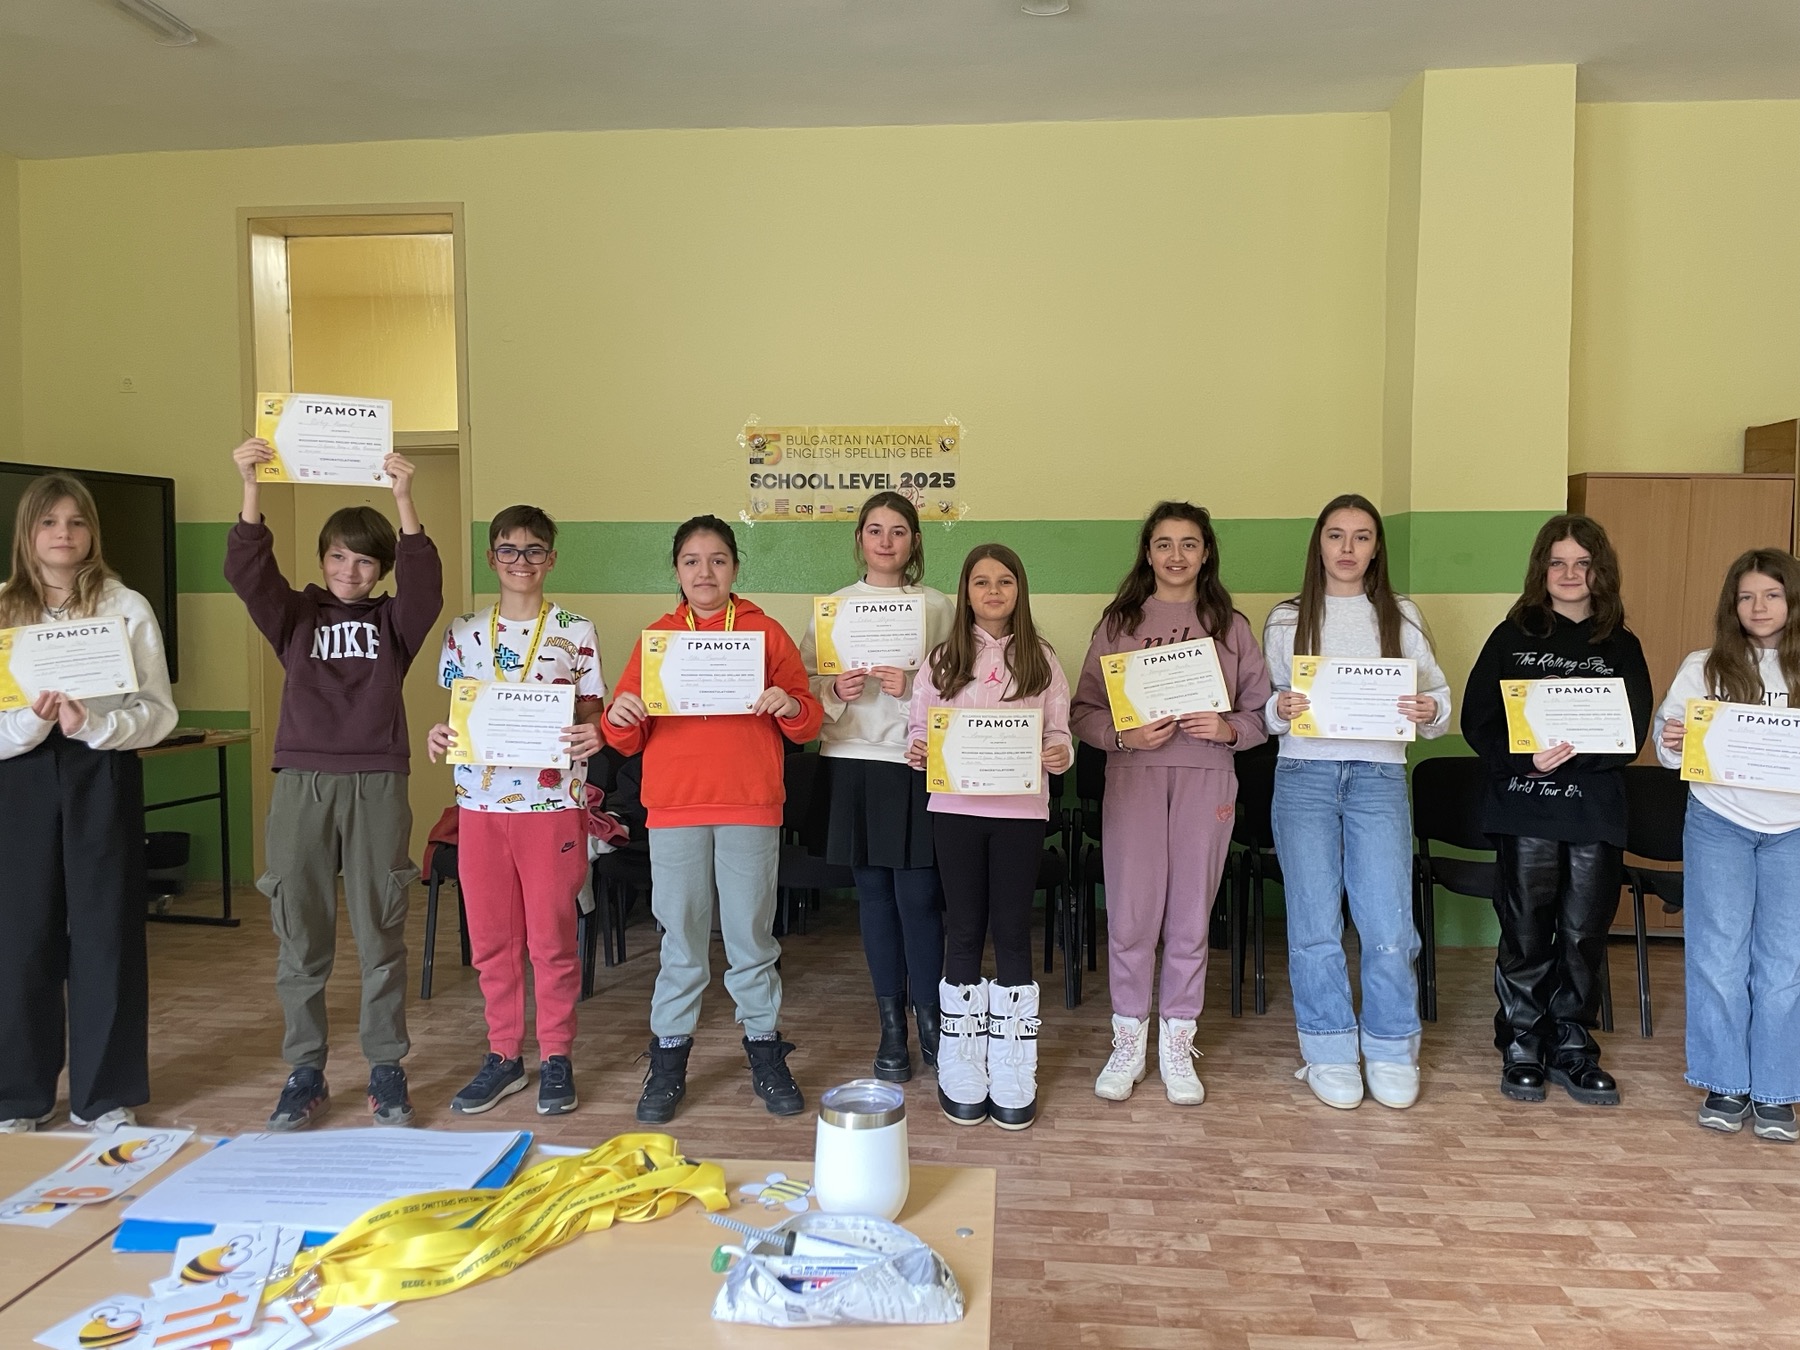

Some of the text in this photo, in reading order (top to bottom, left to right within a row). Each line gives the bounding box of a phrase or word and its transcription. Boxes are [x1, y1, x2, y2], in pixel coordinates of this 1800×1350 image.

[306, 405, 377, 418] ГРАМОТА
[786, 434, 932, 446] BULGARIAN NATIONAL
[786, 447, 841, 459] ENGLISH
[845, 447, 906, 459] SPELLING
[911, 447, 933, 459] BEE
[750, 472, 956, 490] SCHOOL LEVEL 2025
[855, 604, 913, 613] ГРАМОТА
[37, 626, 110, 641] ГРАМОТА
[310, 621, 380, 660] NIKE
[687, 642, 751, 650] ГРАМОТА
[1143, 649, 1203, 666] ГРАМОТА
[1337, 667, 1402, 676] ГРАМОТА
[497, 692, 560, 703] ГРАМОТА
[968, 719, 1029, 728] ГРАМОТА
[1737, 714, 1800, 728] ГРАМОТ
[1538, 781, 1561, 796] Tour
